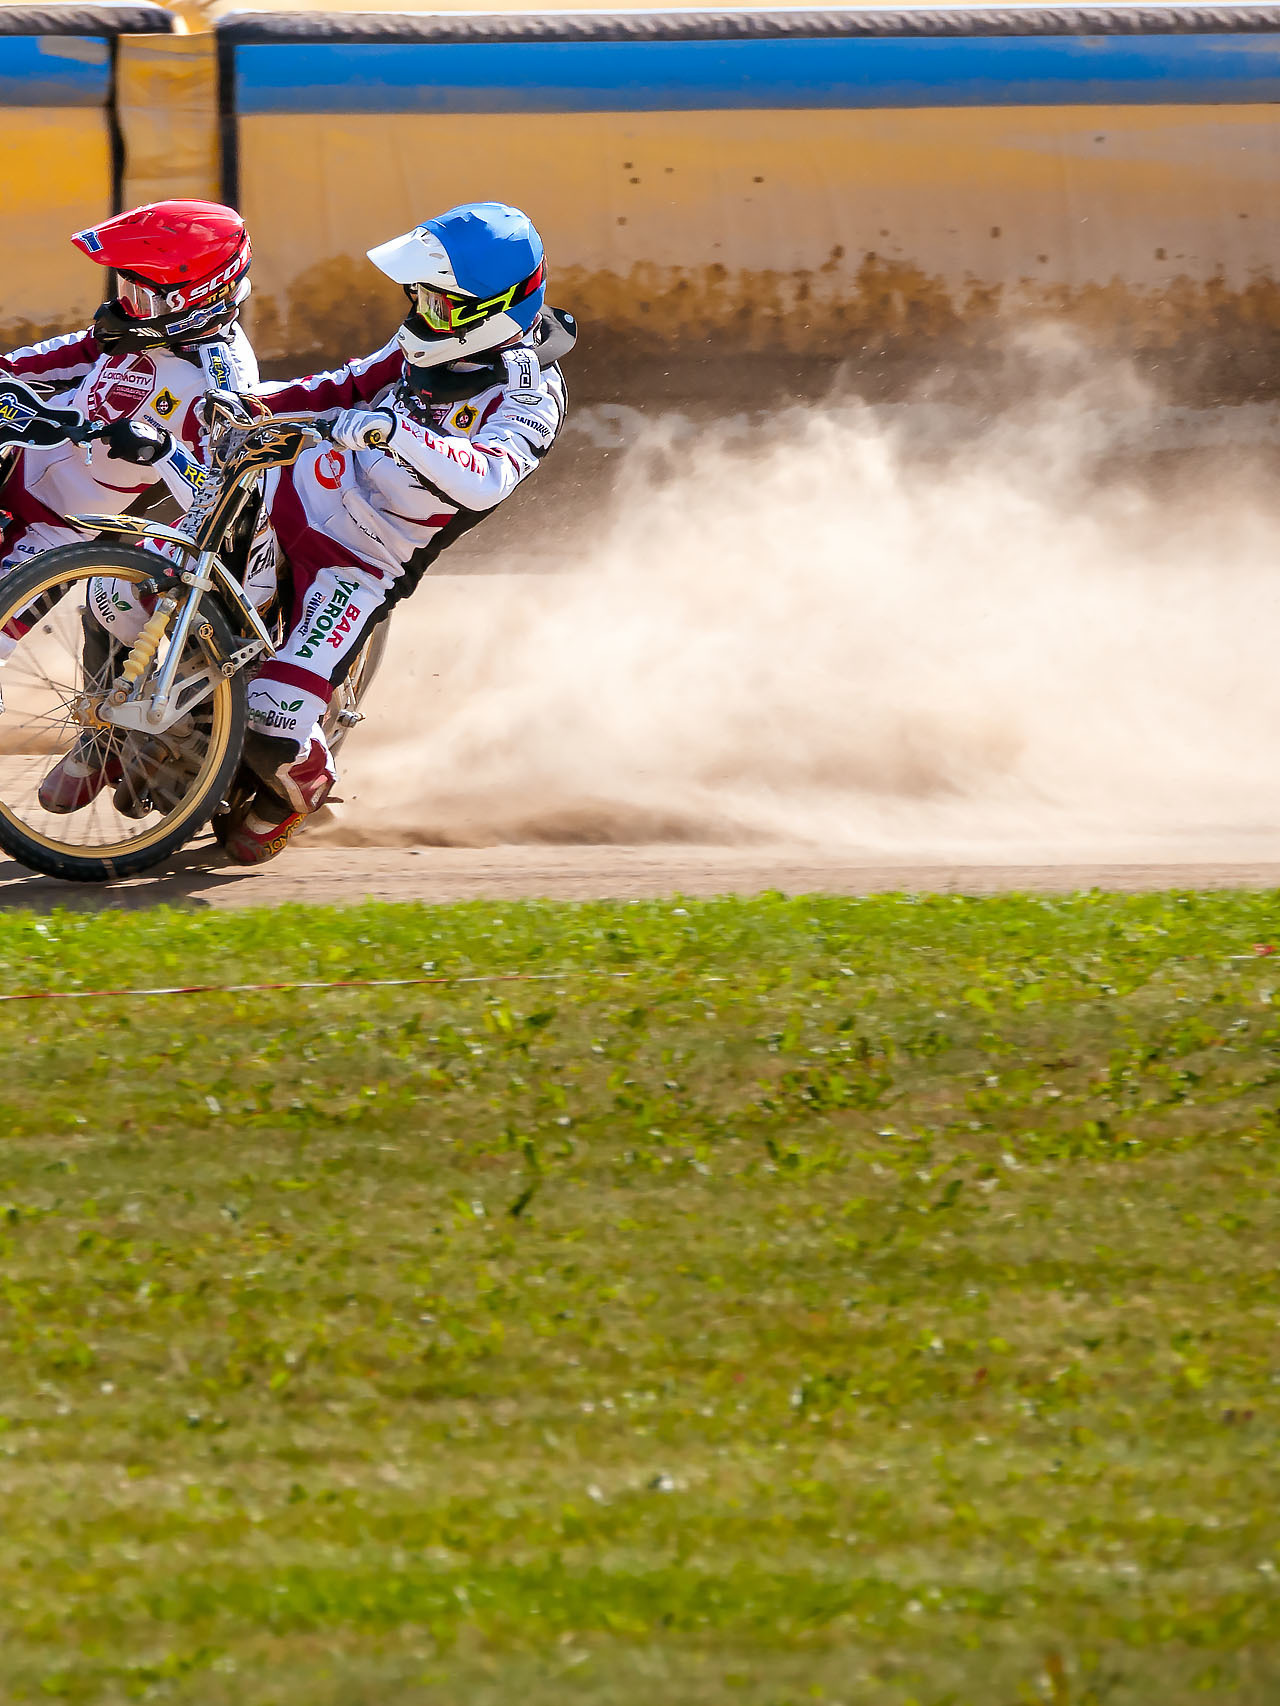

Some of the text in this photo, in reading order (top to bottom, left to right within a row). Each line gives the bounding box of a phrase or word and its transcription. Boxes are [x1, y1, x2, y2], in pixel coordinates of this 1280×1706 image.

[102, 371, 152, 386] LOKOMOTIV
[294, 575, 360, 659] VERONA
[326, 604, 361, 648] BAR
